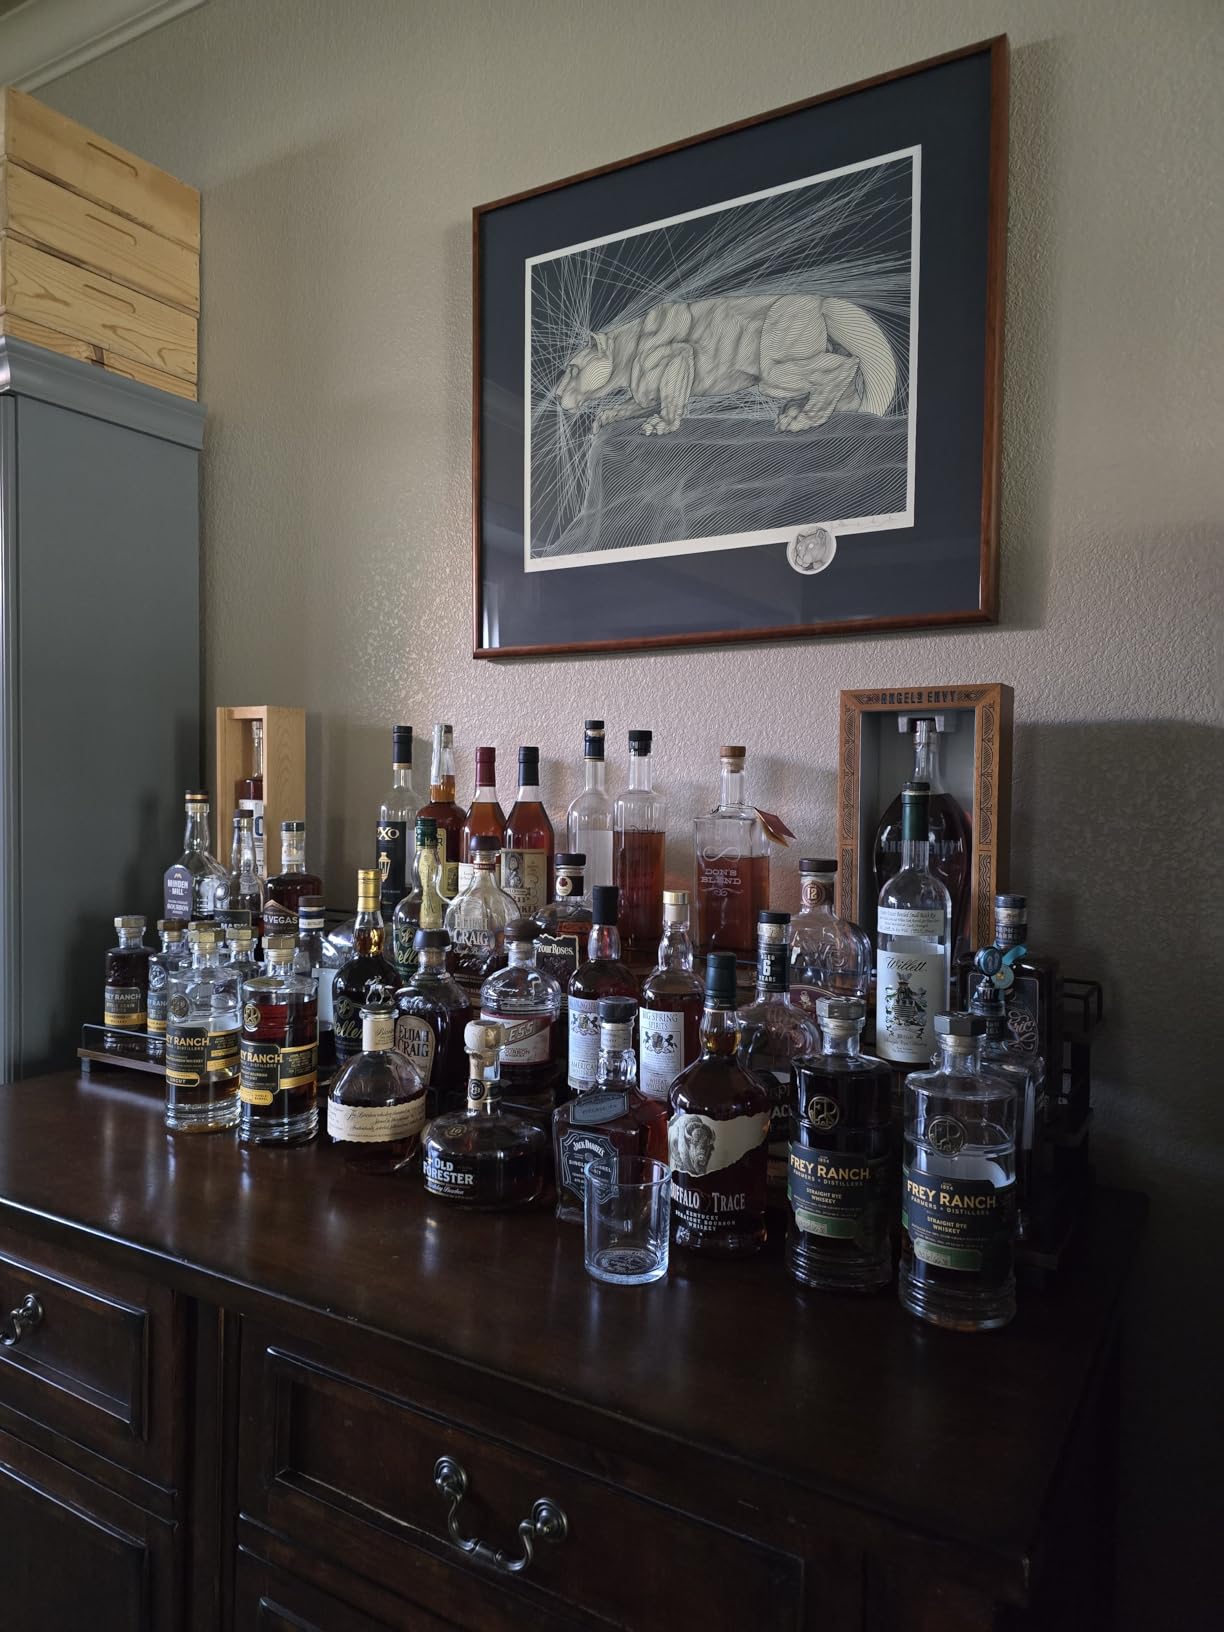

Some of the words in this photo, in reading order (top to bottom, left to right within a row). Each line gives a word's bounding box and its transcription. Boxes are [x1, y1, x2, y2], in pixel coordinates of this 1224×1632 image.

[927, 689, 957, 703] ENVY
[704, 868, 737, 876] DON'S
[168, 879, 189, 889] MINDEN
[699, 876, 742, 885] BLEND
[171, 887, 184, 896] MILL
[268, 915, 299, 924] VEGAS
[453, 929, 489, 946] CRAIG
[762, 959, 772, 976] 6
[887, 957, 928, 972] Willett
[651, 1012, 678, 1023] SPRING
[648, 1020, 669, 1031] SPIRITS
[399, 1024, 430, 1043] ELIJAH
[173, 1036, 210, 1047] RANCH
[398, 1038, 430, 1058] CRAIG
[247, 1052, 283, 1064] RANCH
[573, 1139, 585, 1152] JACK
[434, 1159, 454, 1172] OLD
[790, 1154, 814, 1174] FREY
[817, 1164, 869, 1180] RANCH
[423, 1160, 474, 1186] FORESTER
[793, 1168, 815, 1182] FARMERS
[823, 1179, 864, 1187] DISTILLERS
[806, 1187, 831, 1199] STRAIGHT
[831, 1192, 842, 1200] RYE
[811, 1194, 836, 1204] WHISKEY
[907, 1180, 937, 1202] FREY
[940, 1191, 997, 1209] RANCH
[711, 1191, 747, 1213] TRACE
[911, 1195, 937, 1210] FARMERS
[946, 1207, 991, 1216] DISTILLERS
[675, 1209, 701, 1224] STRAIGHT
[703, 1219, 736, 1227] BOURBON
[685, 1209, 719, 1221] KENTUCKY
[689, 1221, 717, 1232] WHISKEY
[926, 1216, 954, 1228] STRAIGHT
[932, 1223, 961, 1234] WHISKEY
